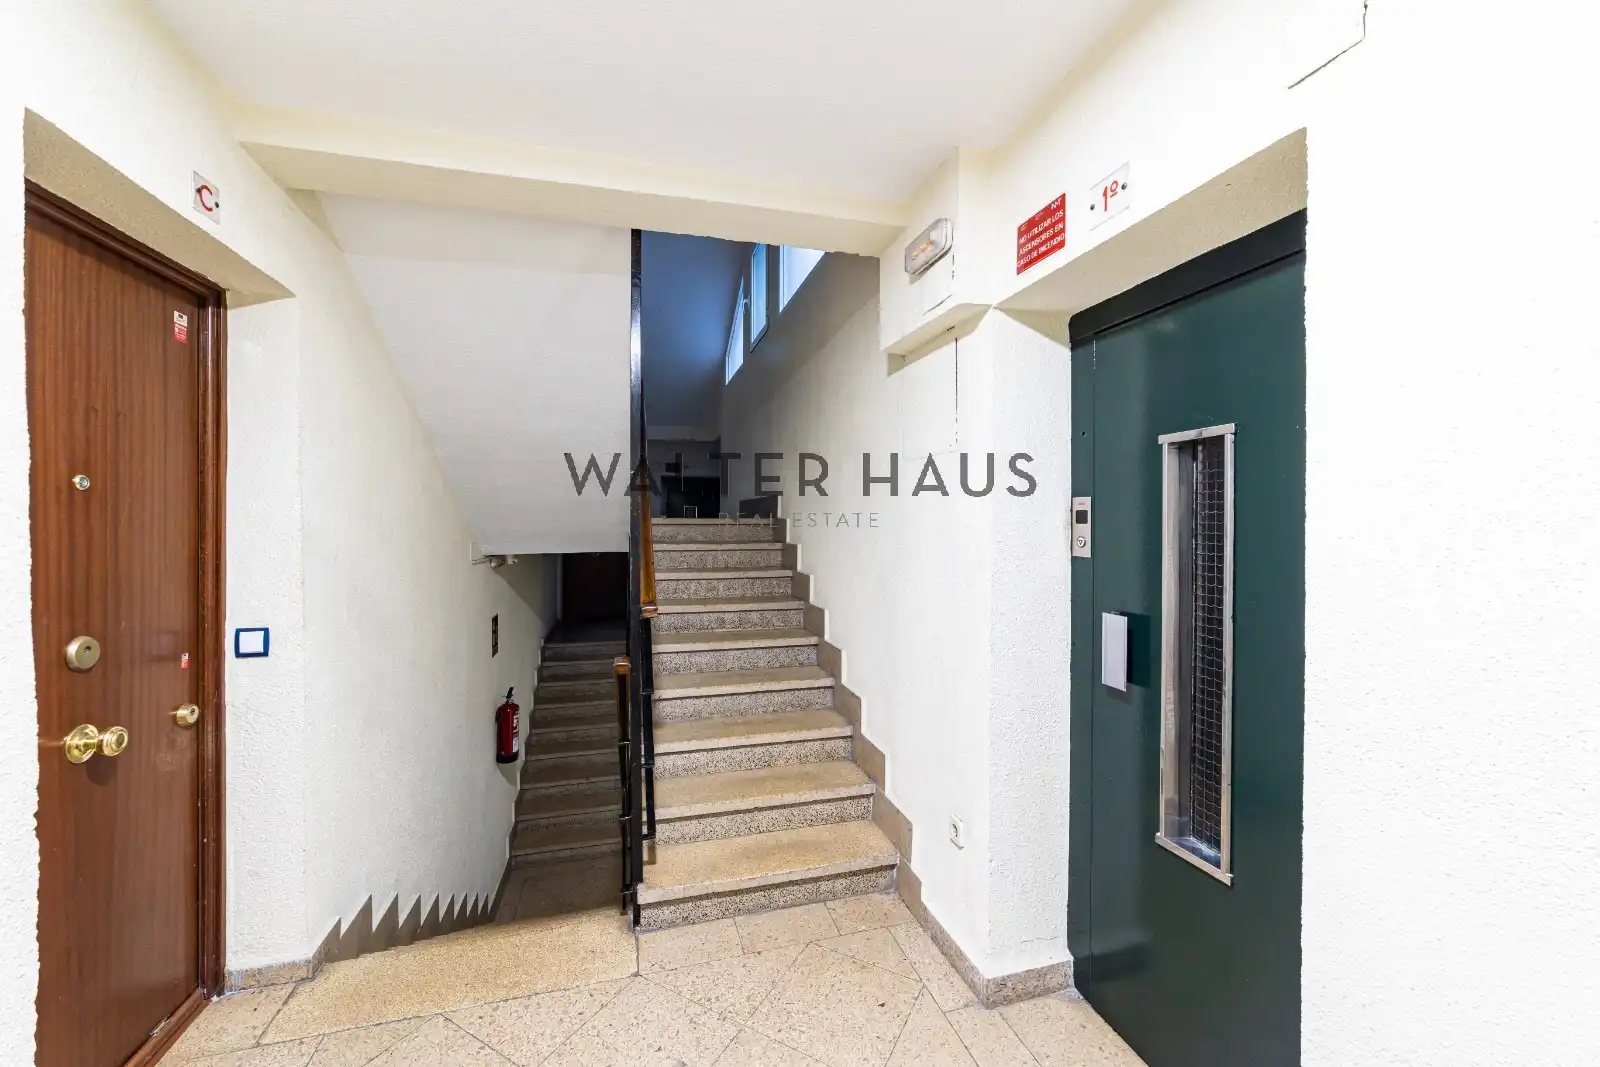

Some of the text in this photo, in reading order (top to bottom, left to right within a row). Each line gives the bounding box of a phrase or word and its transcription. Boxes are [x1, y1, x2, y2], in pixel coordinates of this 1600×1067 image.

[198, 184, 213, 212] C
[1018, 221, 1064, 256] ASCENSORES EN
[1019, 235, 1028, 244] NO
[1028, 218, 1052, 239] UTILIZAR
[1052, 209, 1064, 222] LOS
[1017, 233, 1065, 267] CASO DE INCENDIO
